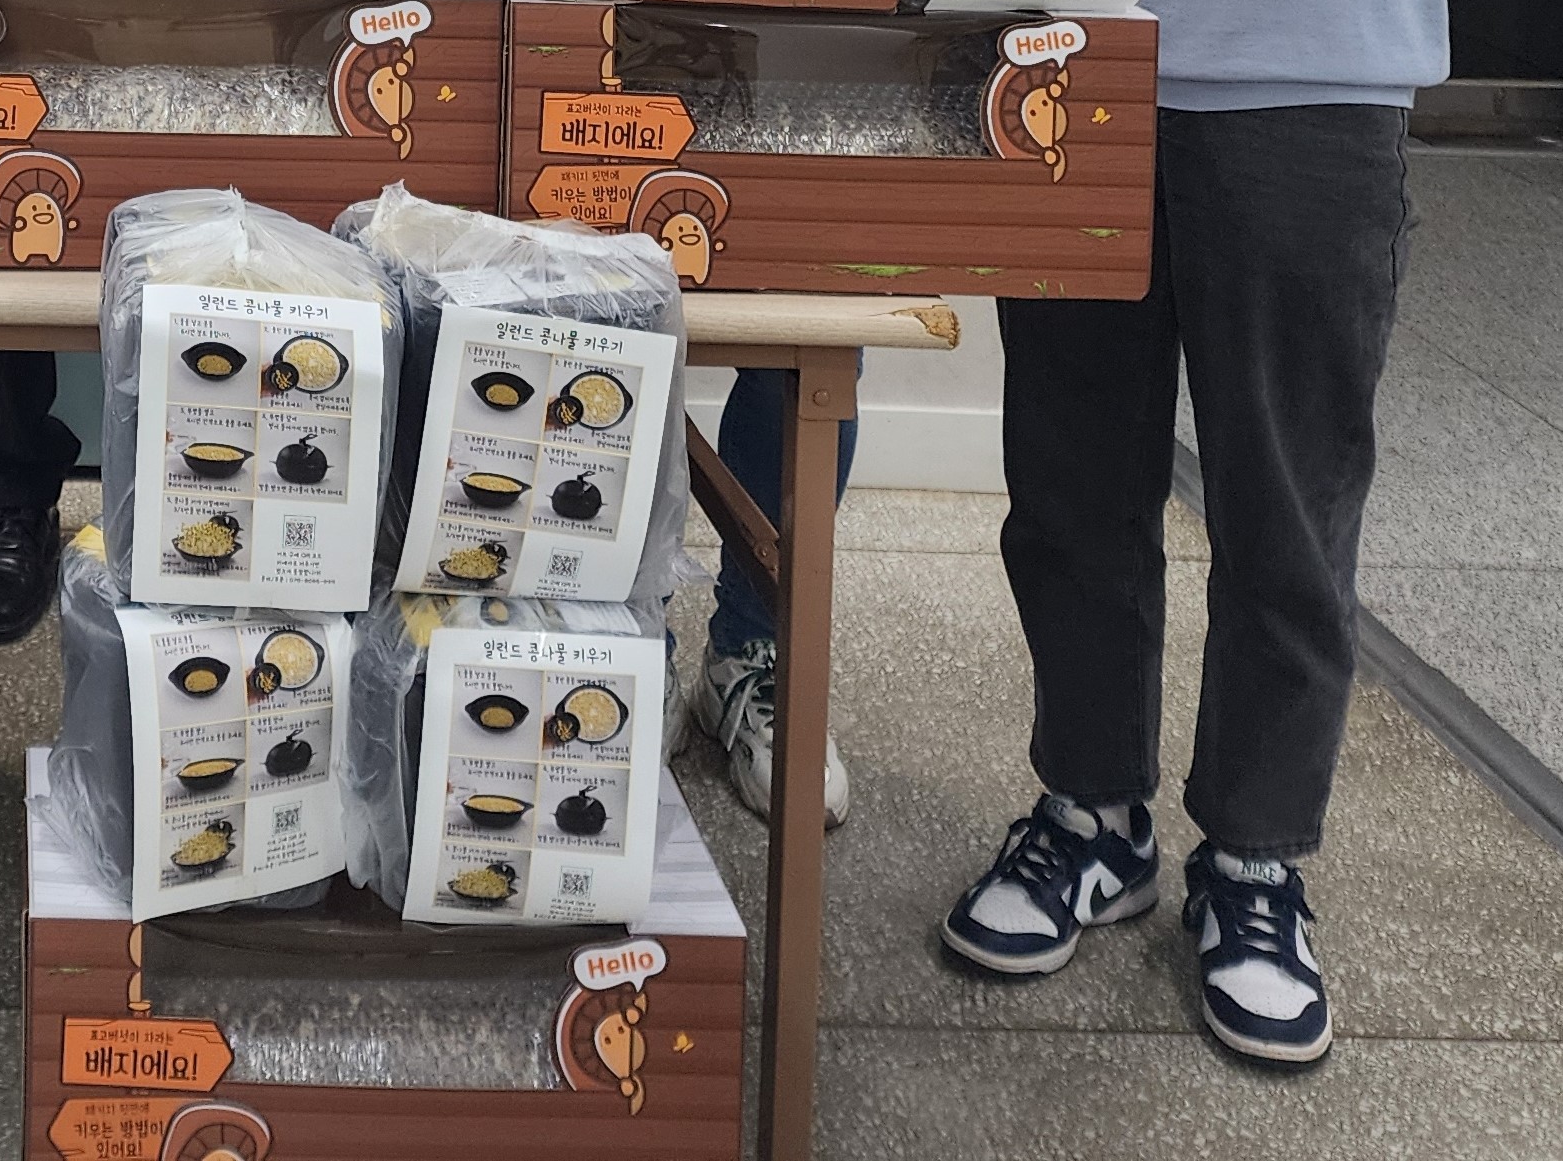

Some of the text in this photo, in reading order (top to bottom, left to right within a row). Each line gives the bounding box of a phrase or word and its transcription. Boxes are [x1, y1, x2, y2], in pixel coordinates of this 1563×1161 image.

[361, 8, 421, 34] Hello
[1015, 29, 1076, 57] Hello
[566, 103, 642, 118] 표고버섯이 자라는
[562, 119, 663, 150] 배지에요!
[551, 186, 632, 203] 키우는 방법이
[571, 204, 612, 221] 있어요!
[199, 293, 329, 320] 일런드 콩나물 키우기
[496, 321, 625, 355] 일런드 콩나물 키우기
[1239, 857, 1278, 882] NIKE
[587, 949, 654, 980] Hello
[85, 1046, 198, 1081] 배지에요!
[74, 1119, 164, 1139] 키우는 방법이
[97, 1139, 142, 1159] 있어요!
